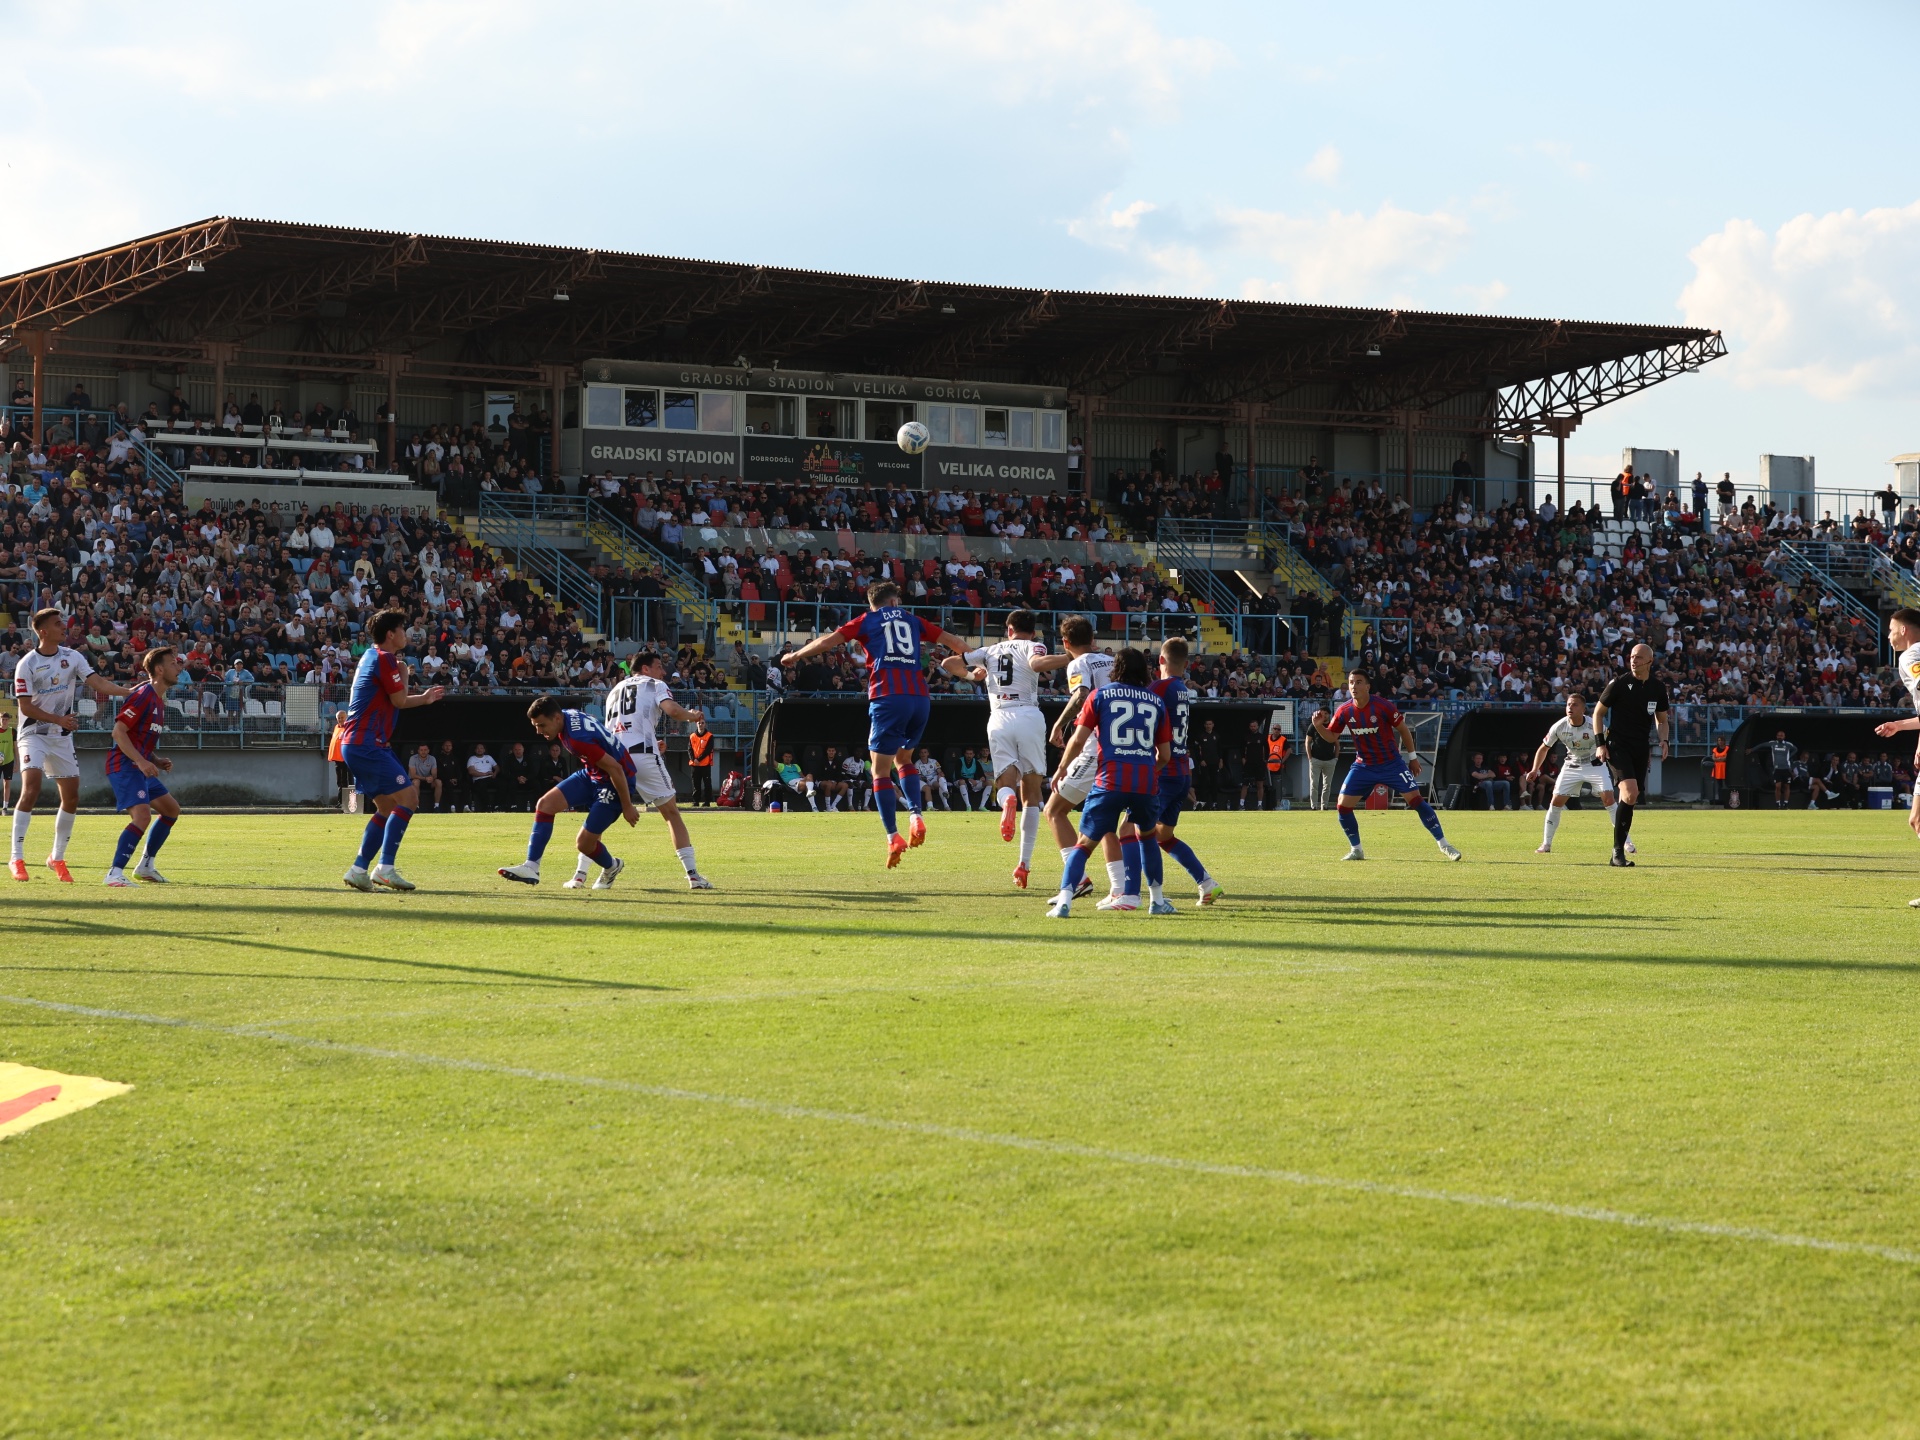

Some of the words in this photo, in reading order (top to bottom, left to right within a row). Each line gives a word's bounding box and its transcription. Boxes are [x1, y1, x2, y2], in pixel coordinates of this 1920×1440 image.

[681, 371, 750, 386] GRADSKI
[768, 376, 835, 391] STADION
[853, 381, 908, 395] VELIKA
[925, 386, 982, 400] GORICA
[591, 446, 662, 462] GRADSKI
[667, 449, 735, 465] STADION
[750, 454, 795, 464] DOBRODOŠLI
[877, 461, 911, 469] WELCOME
[809, 472, 833, 484] Velika
[835, 473, 859, 484] Gorica
[938, 462, 996, 478] VELIKA
[998, 465, 1057, 481] GORICA
[881, 620, 915, 656] 19
[883, 655, 917, 665] SuperSport
[998, 653, 1013, 686] 9
[1109, 699, 1158, 749] 23
[1351, 726, 1380, 735] TOMMY
